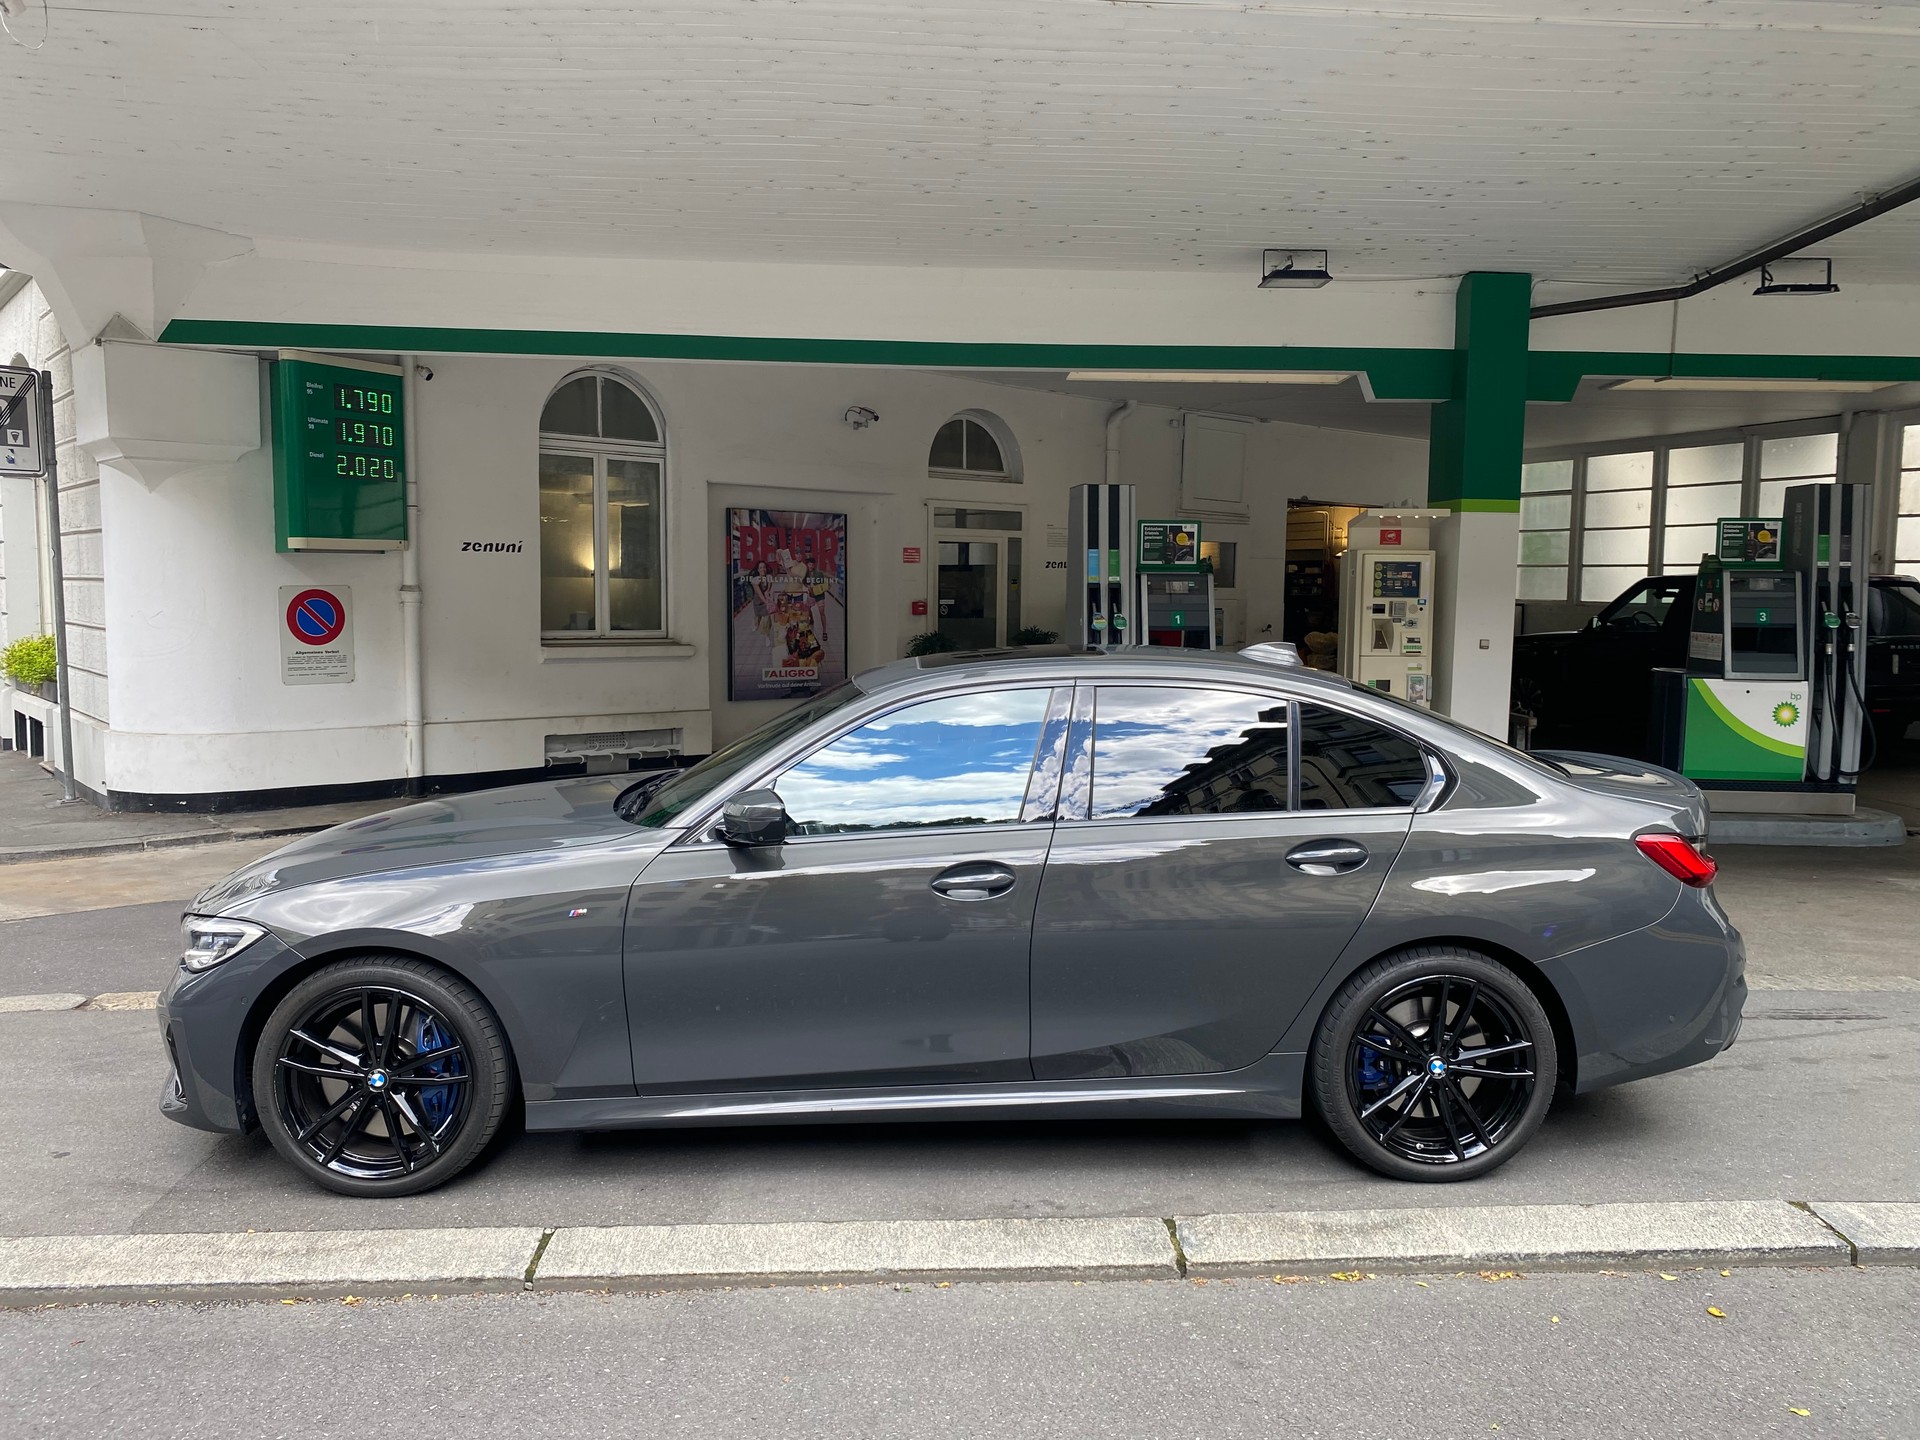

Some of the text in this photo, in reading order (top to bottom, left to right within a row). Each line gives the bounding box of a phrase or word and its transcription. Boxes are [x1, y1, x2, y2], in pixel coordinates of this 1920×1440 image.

[341, 388, 392, 414] 1.790
[342, 422, 393, 446] 1.970
[336, 455, 394, 479] 2.020
[461, 540, 523, 553] zenuni
[757, 576, 803, 584] GRILLPARTY
[1175, 615, 1181, 625] 1
[1759, 612, 1767, 622] 3
[769, 669, 815, 678] ALIGRO
[1790, 691, 1802, 702] bp
